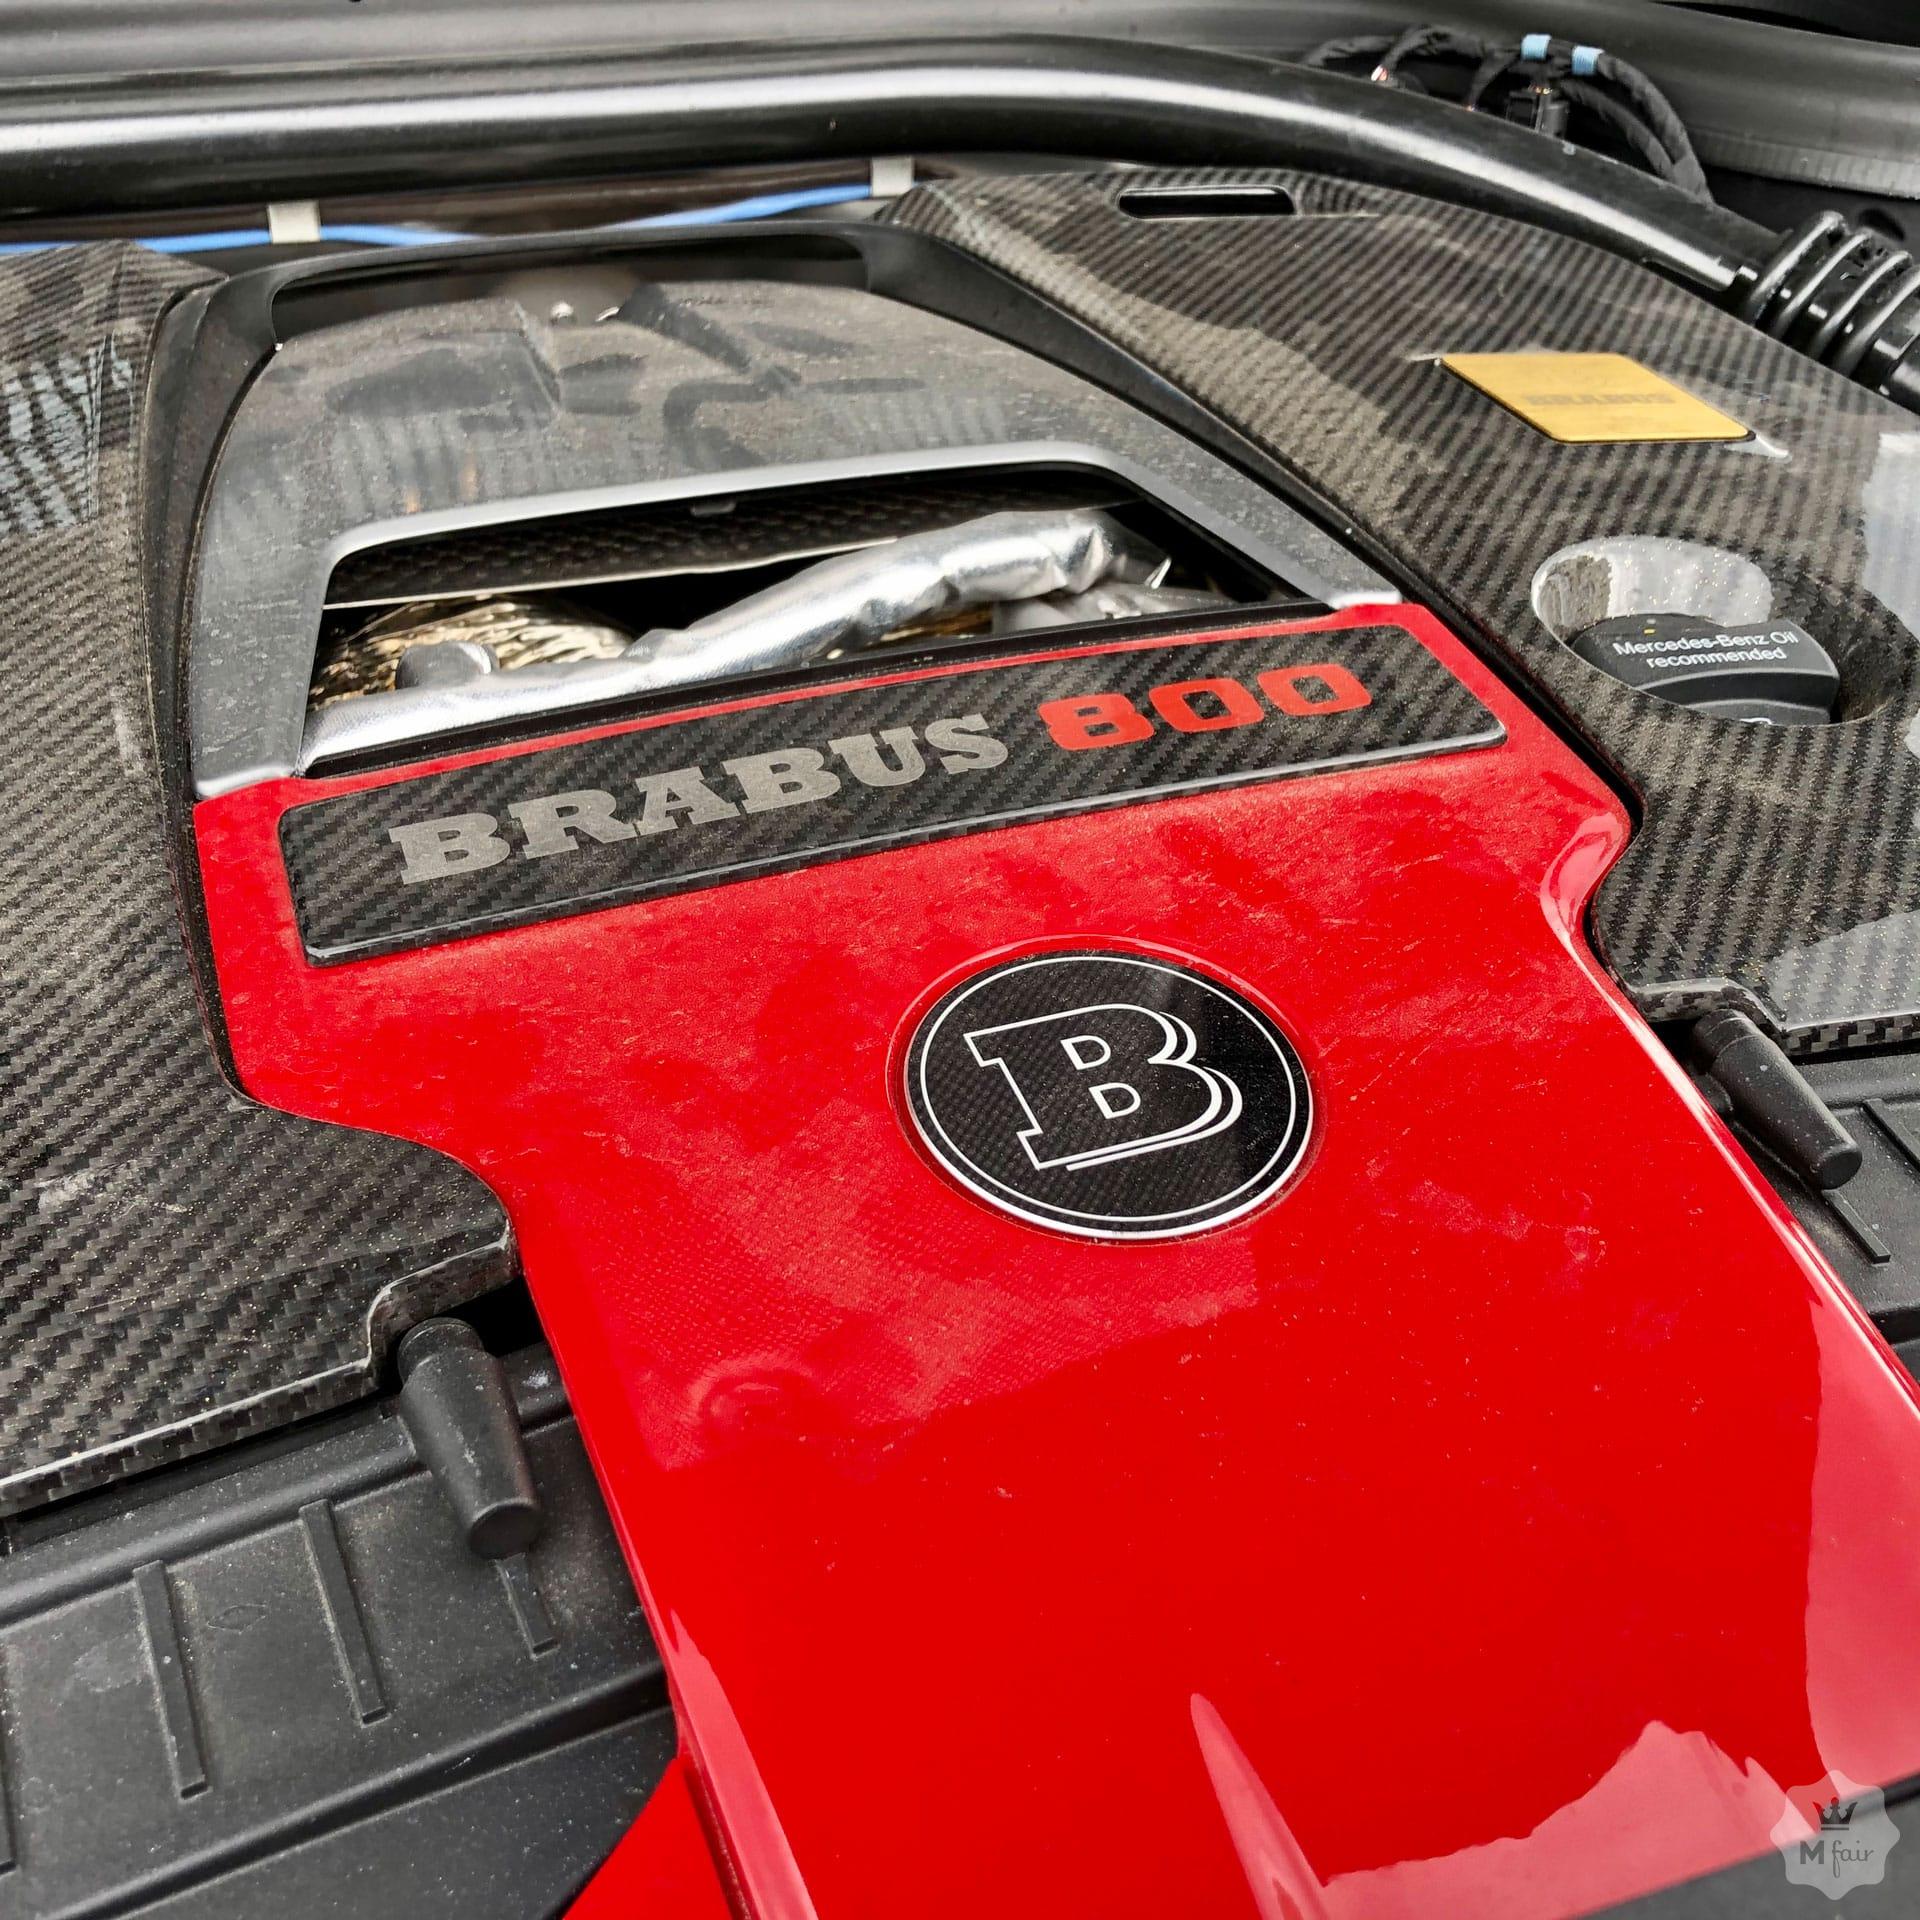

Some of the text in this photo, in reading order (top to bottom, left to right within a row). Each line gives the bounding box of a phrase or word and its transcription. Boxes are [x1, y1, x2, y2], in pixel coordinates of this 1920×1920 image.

[1612, 630, 1800, 656] Mercedes-Benz Oil
[1646, 647, 1787, 669] recommended
[387, 663, 1372, 884] BRABUS 800
[964, 1003, 1243, 1171] B
